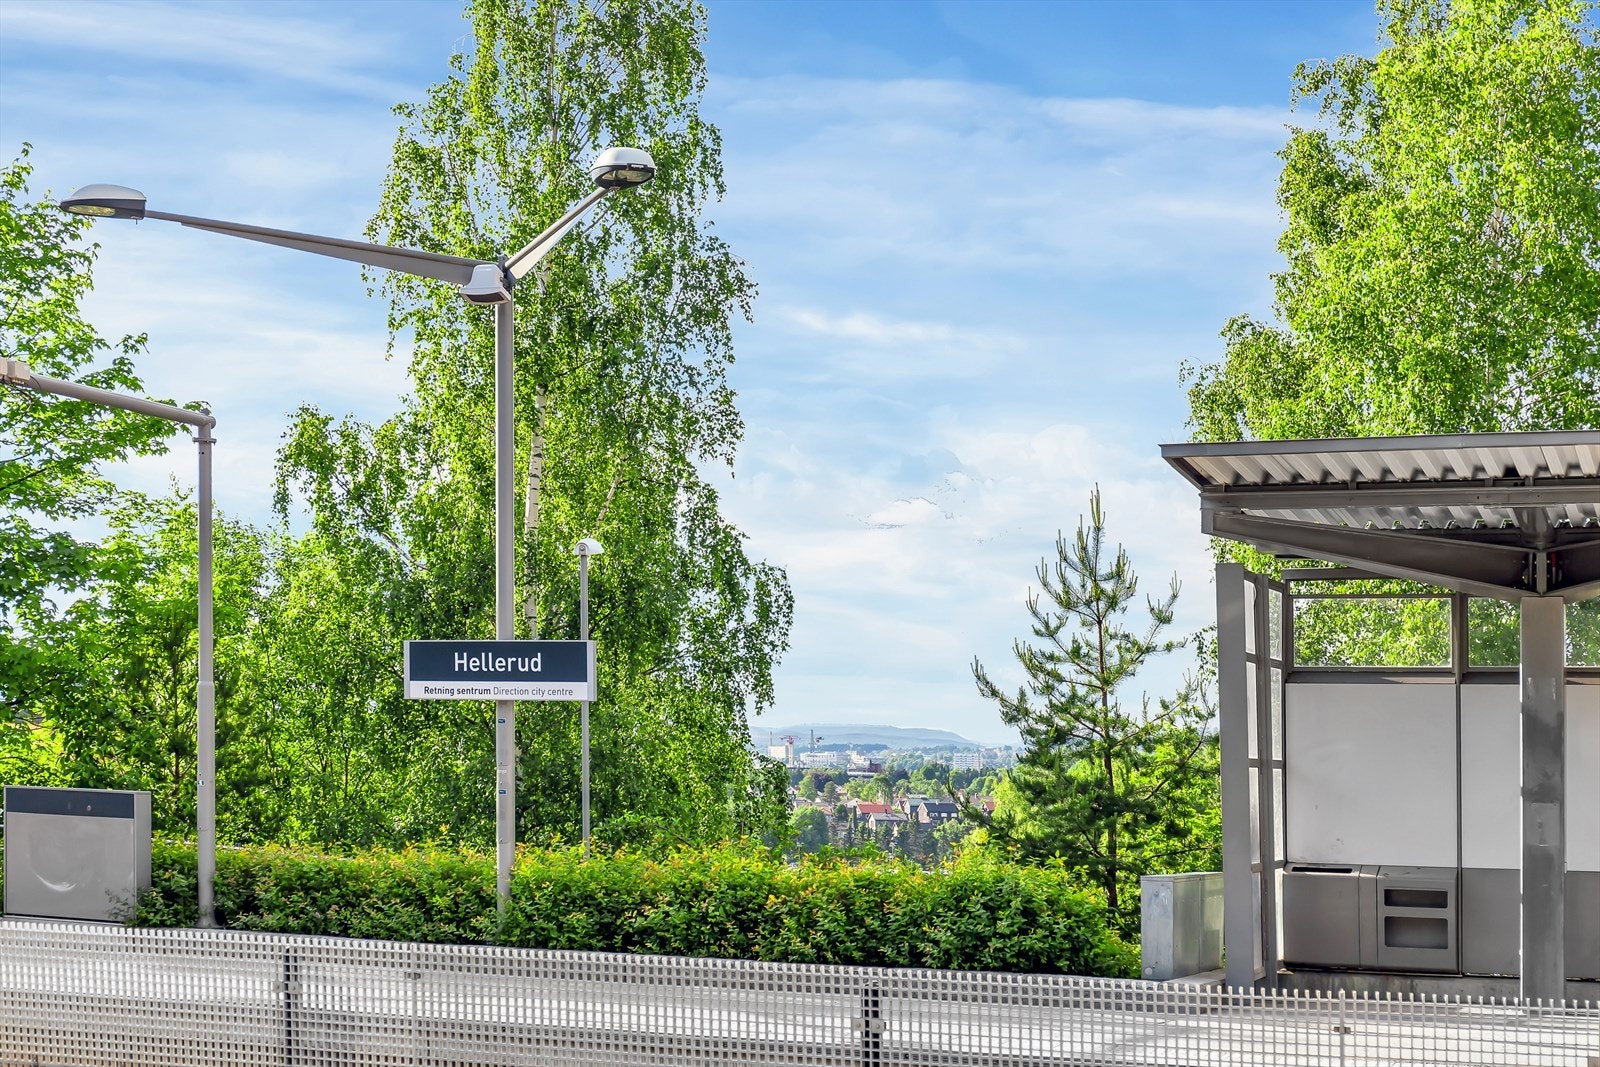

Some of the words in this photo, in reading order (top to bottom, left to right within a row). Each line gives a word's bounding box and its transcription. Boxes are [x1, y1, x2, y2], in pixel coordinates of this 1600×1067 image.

[454, 652, 542, 672] Hellerud
[424, 686, 455, 697] Retning
[456, 687, 491, 695] sentrum
[493, 686, 530, 696] Direction
[531, 687, 546, 698] city
[547, 688, 574, 697] centre
